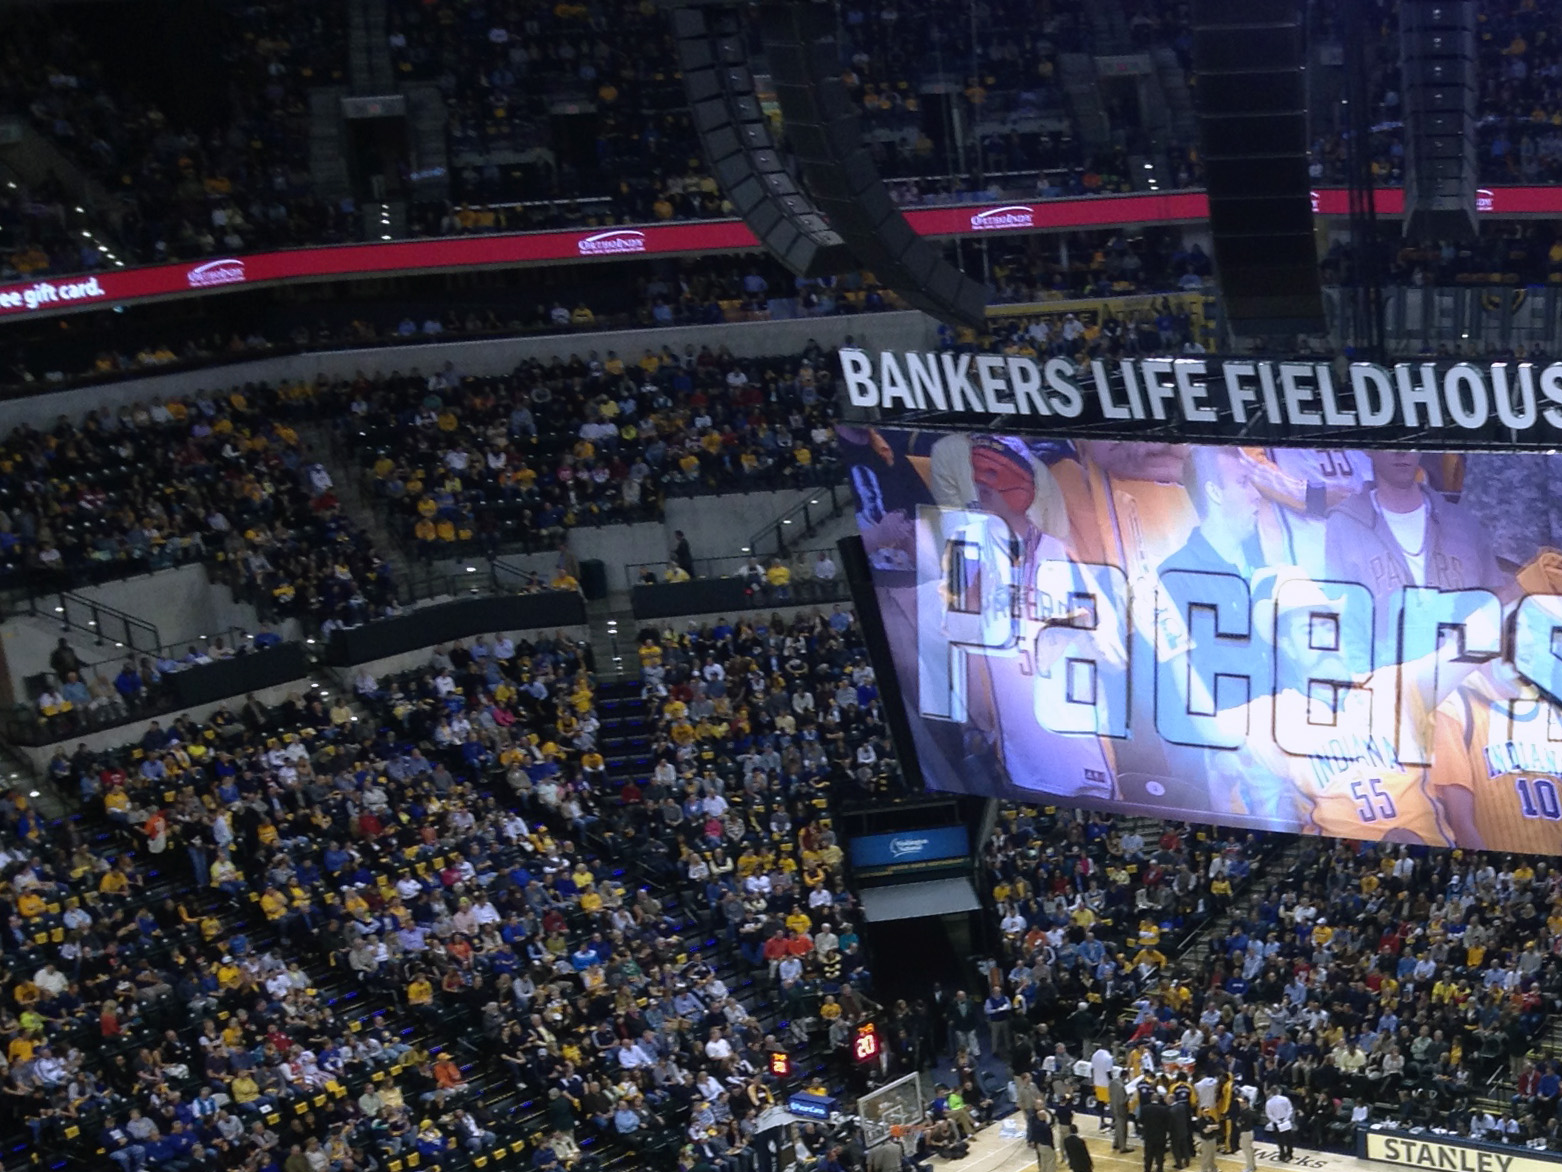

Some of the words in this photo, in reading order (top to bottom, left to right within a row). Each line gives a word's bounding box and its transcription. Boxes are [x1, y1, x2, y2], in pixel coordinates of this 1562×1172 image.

[24, 283, 57, 309] gift
[839, 347, 1083, 418] BANKERS
[1092, 357, 1218, 422] LIFE
[1350, 779, 1396, 822] 55
[1516, 778, 1562, 820] 10
[857, 1035, 875, 1057] 20
